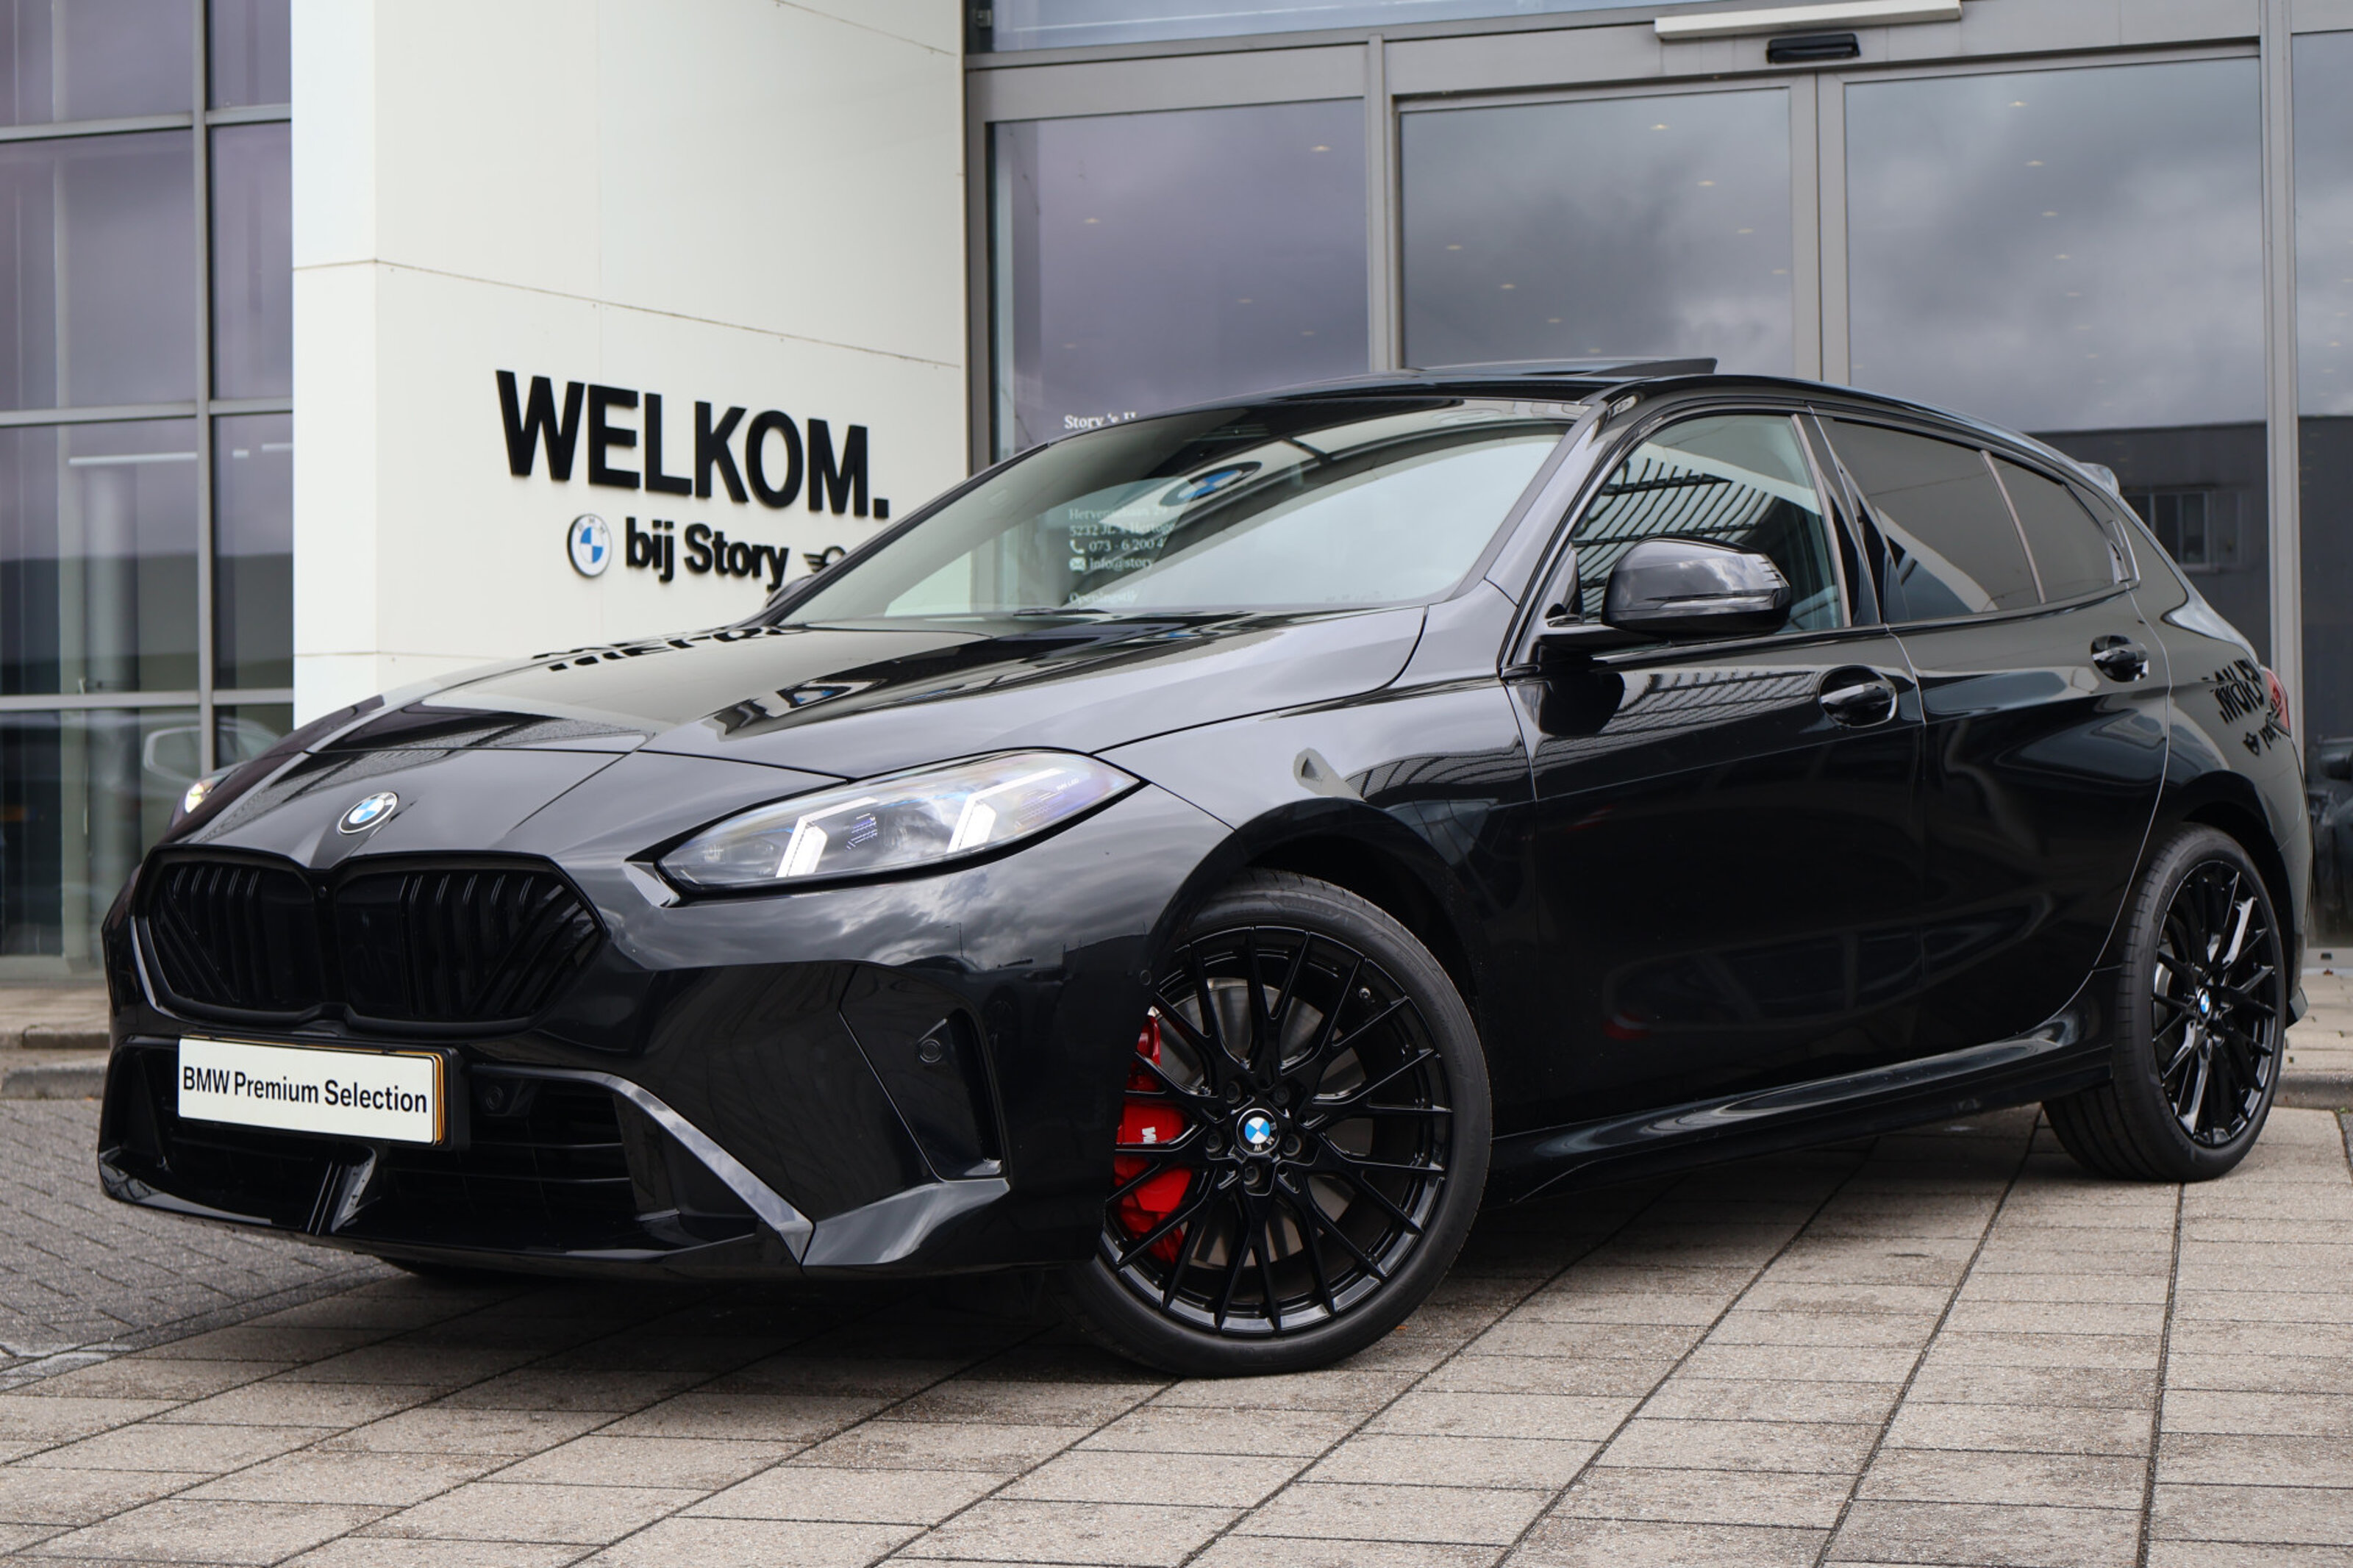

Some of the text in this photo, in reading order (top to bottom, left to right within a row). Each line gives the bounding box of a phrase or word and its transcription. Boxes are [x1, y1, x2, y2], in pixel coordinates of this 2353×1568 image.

[496, 370, 889, 519] WELKOM.
[626, 517, 789, 592] bij Story
[1088, 539, 1112, 552] 073
[183, 1065, 427, 1113] BMW Premium Selection
